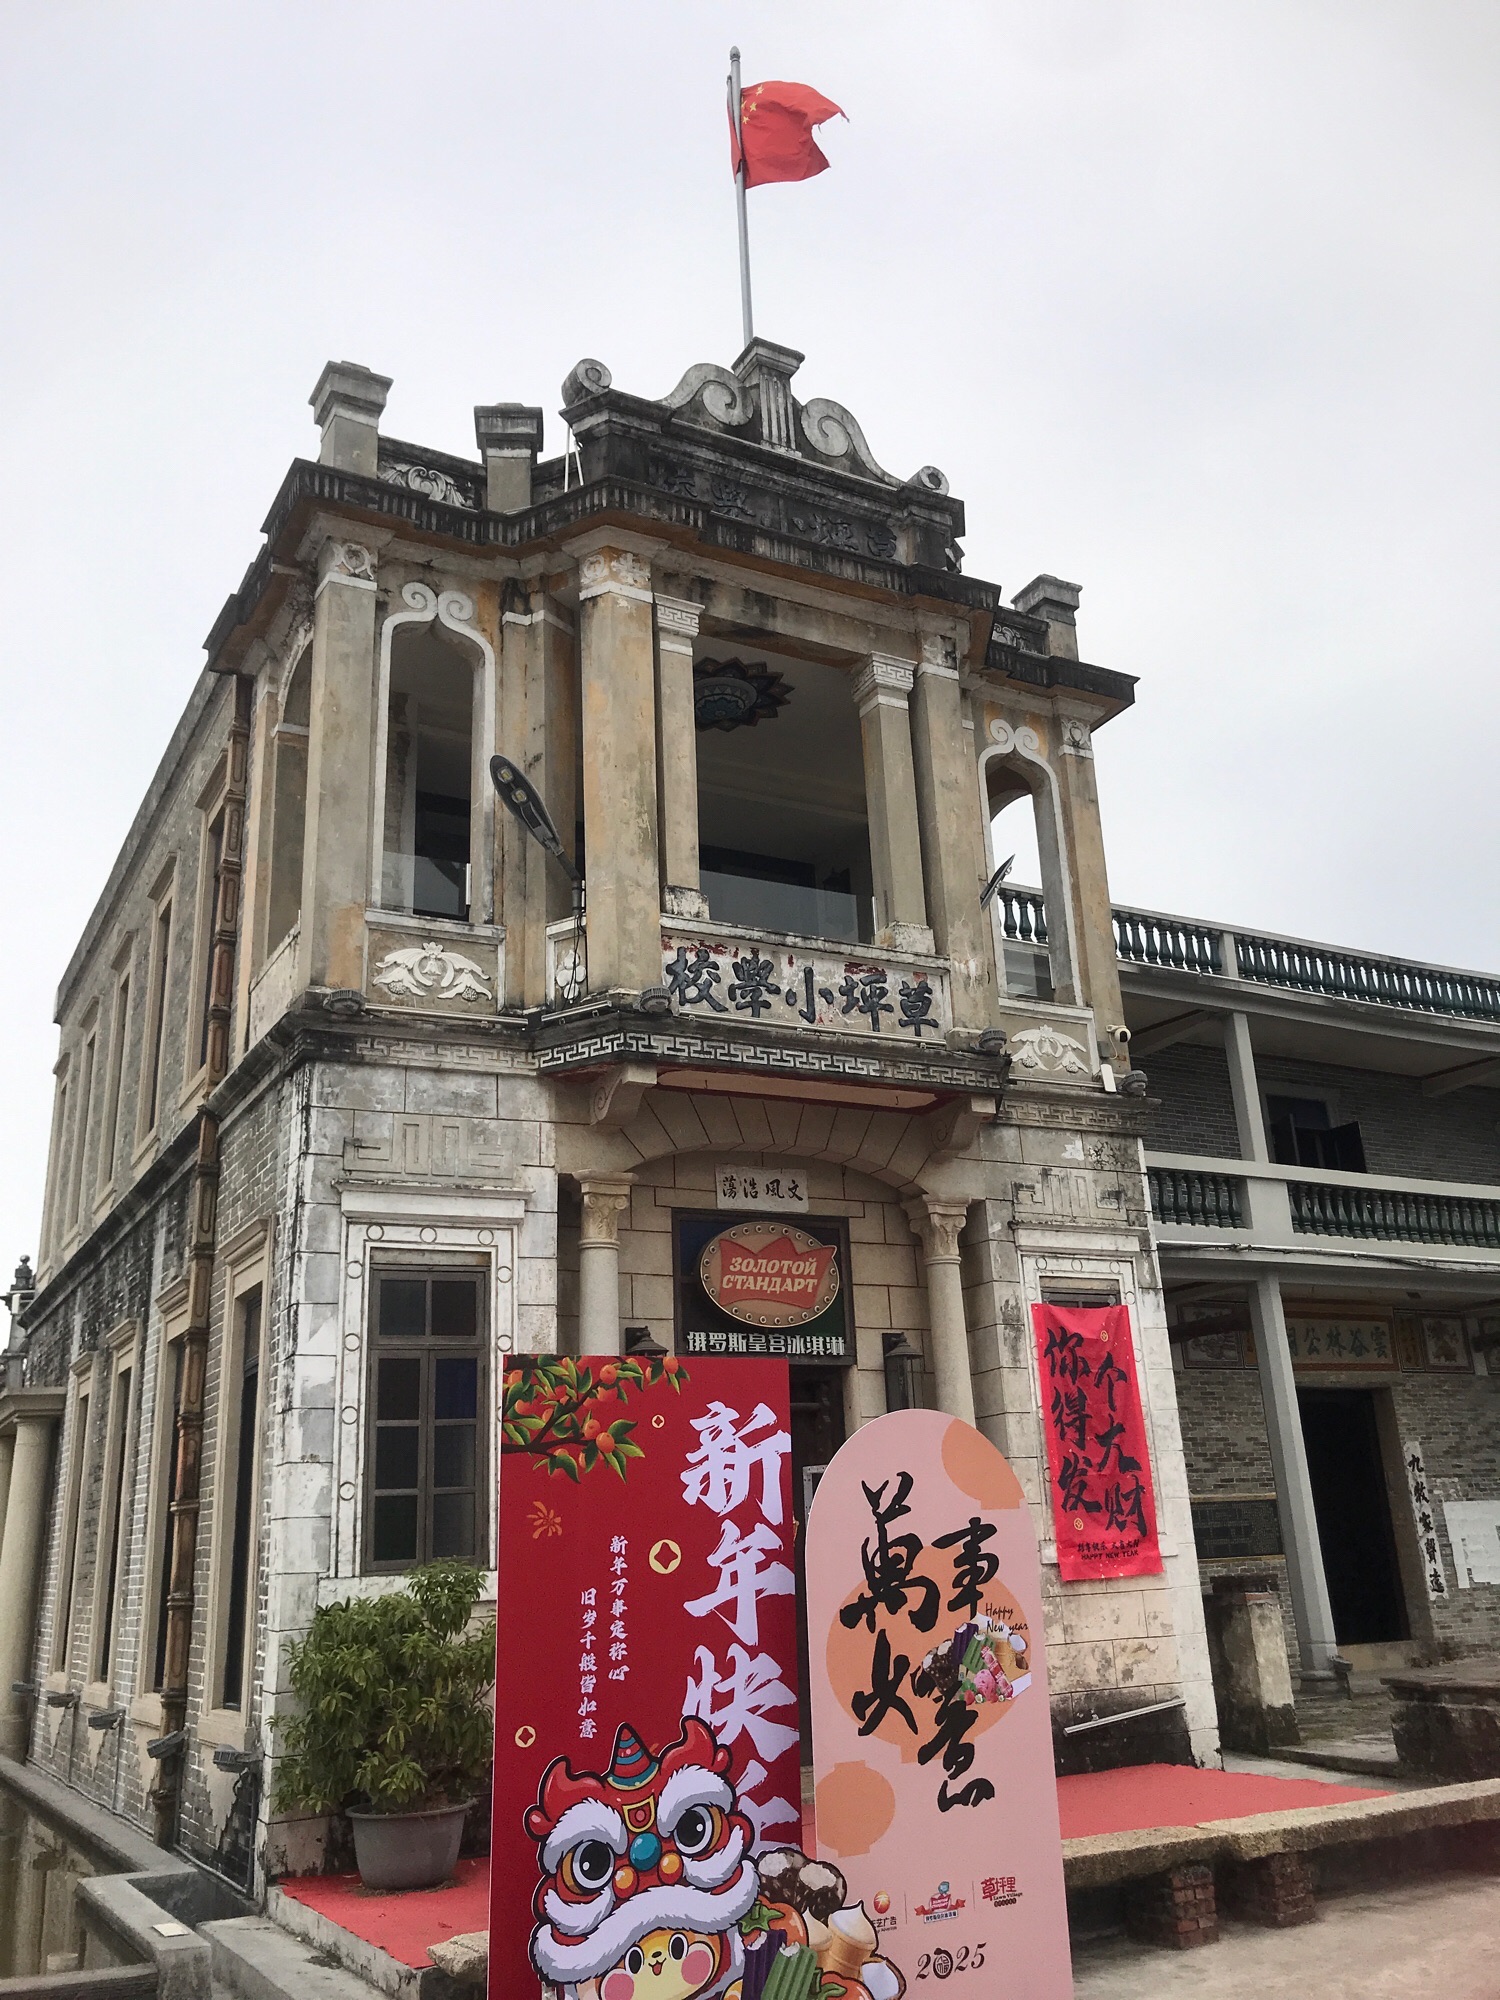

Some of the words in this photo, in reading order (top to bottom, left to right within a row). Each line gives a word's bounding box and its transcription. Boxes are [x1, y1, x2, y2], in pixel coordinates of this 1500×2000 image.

[666, 946, 939, 1037] 草坪小學校
[722, 1175, 804, 1201] 文風浩蕩
[729, 1256, 817, 1276] ЗОЛОТОЙ
[722, 1275, 818, 1294] СТАНДАРТ
[686, 1331, 846, 1356] 俄罗斯皇宫冰淇淋
[1044, 1326, 1102, 1513] 你得发
[1093, 1351, 1148, 1537] 个大财
[608, 1535, 630, 1681] 新年万事定称心
[985, 1602, 1014, 1620] Happy
[986, 1620, 1005, 1634] New
[1009, 1621, 1029, 1637] year
[577, 1588, 598, 1739] 旧岁千般皆如意
[980, 1876, 1017, 1901] 草坪里
[915, 1942, 987, 1979] 2025
